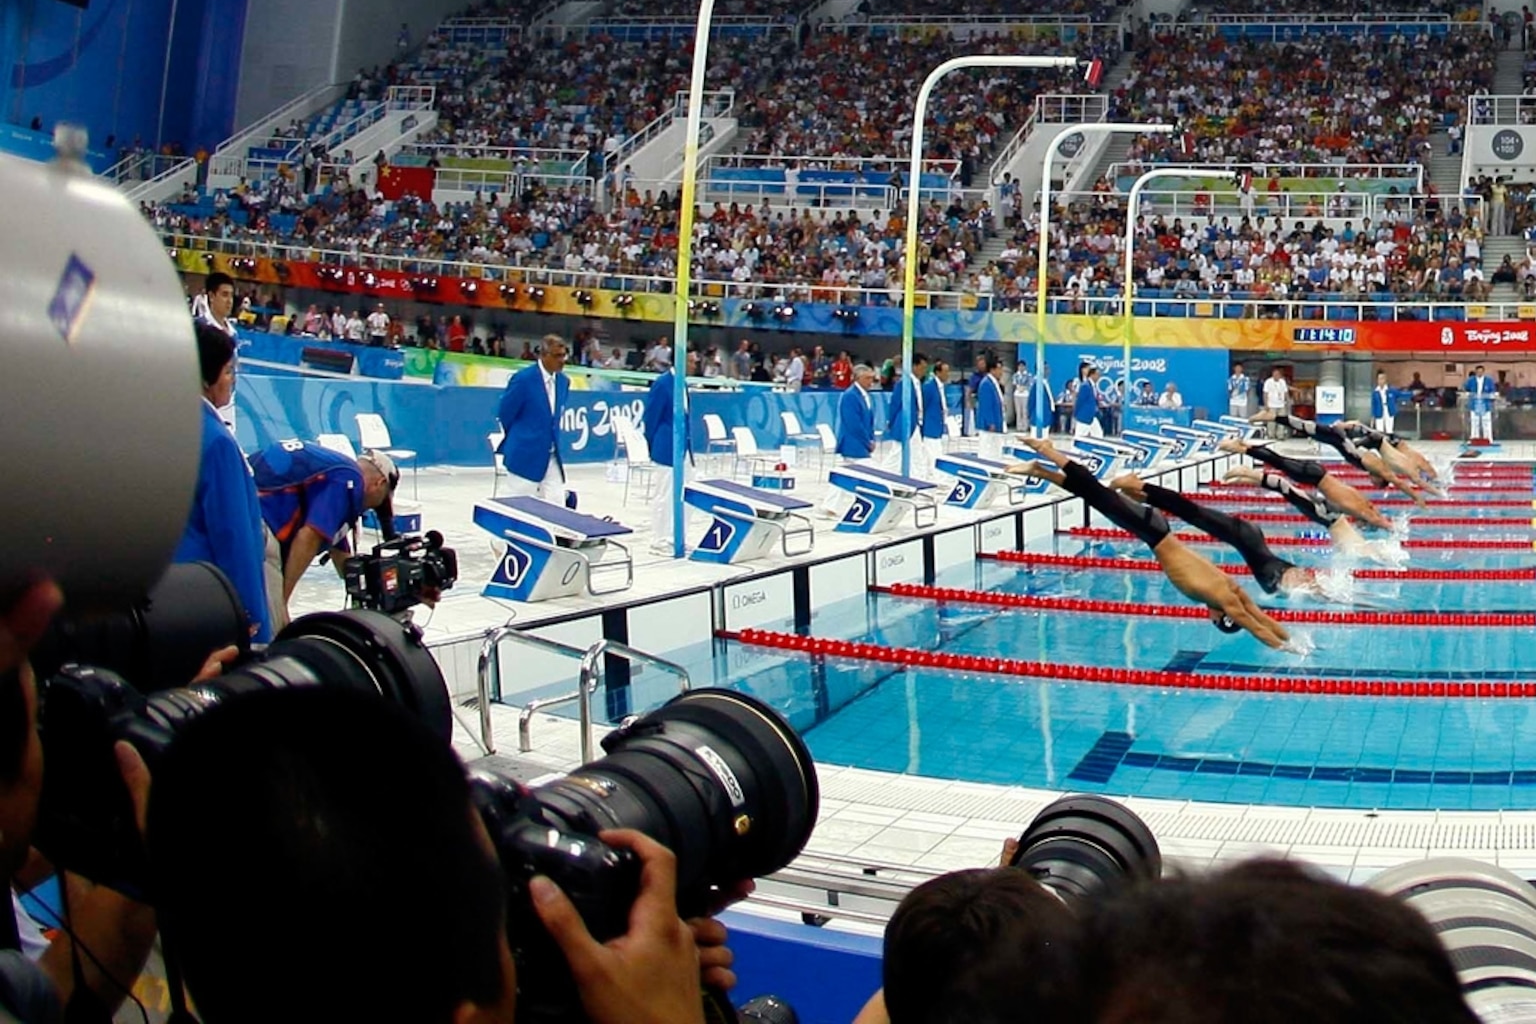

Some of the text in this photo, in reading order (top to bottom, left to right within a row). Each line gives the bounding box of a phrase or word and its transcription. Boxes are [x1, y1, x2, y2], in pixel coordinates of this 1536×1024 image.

[1464, 329, 1529, 344] Beijing 2008
[1131, 358, 1167, 372] 2008
[955, 484, 966, 501] 3
[852, 504, 864, 522] 2
[712, 527, 722, 548] 1
[504, 554, 519, 574] 0
[742, 592, 767, 607] OMEGA
